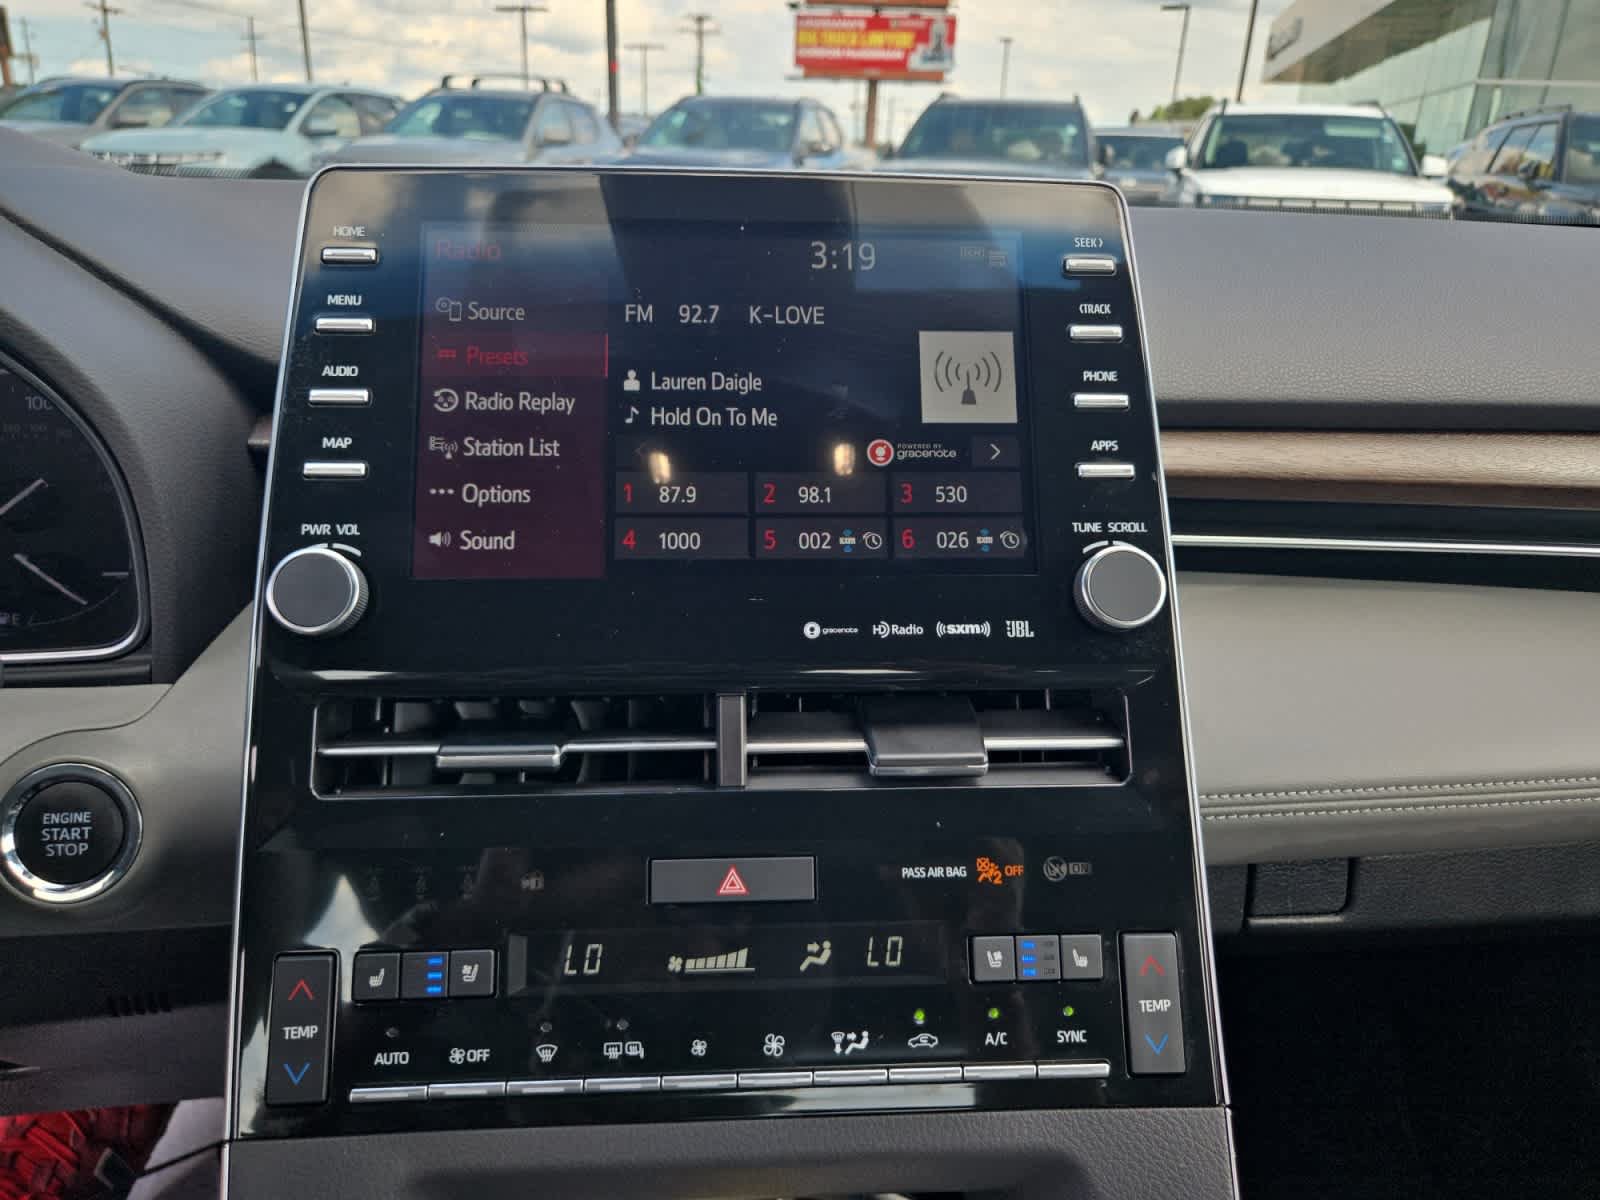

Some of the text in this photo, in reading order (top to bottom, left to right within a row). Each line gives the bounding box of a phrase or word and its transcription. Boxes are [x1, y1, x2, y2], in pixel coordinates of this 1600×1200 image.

[333, 226, 365, 237] HOME
[437, 240, 501, 260] Radio
[1074, 238, 1097, 248] SEEK
[810, 240, 876, 271] 3:19
[327, 295, 362, 306] MENU
[467, 302, 525, 322] Source
[625, 304, 825, 325] FM 92.7 K-LOVE
[1083, 304, 1111, 314] TRACK
[466, 346, 529, 367] Presets
[322, 366, 358, 377] AUDIO
[1083, 371, 1118, 382] PHONE
[651, 371, 762, 395] Lauren Daigle
[465, 392, 576, 415] Radio Replay
[651, 407, 777, 426] Hold On To Me
[322, 437, 352, 449] MAP
[463, 436, 560, 457] Station List
[1091, 440, 1118, 451] APPS
[897, 449, 957, 460] gracenote
[462, 483, 531, 507] Options
[623, 483, 697, 504] 1 87.9
[763, 484, 832, 504] 2 98.1
[901, 483, 967, 503] 3 530
[301, 524, 360, 535] PWR VOL
[1072, 522, 1148, 533] TUNE SCROLL
[459, 531, 515, 550] Sound
[622, 529, 701, 550] 4 1000
[764, 530, 776, 550] 5
[798, 532, 832, 549] 002
[902, 529, 915, 549] 6
[936, 532, 969, 549] 026
[891, 621, 924, 635] Radio
[1005, 620, 1034, 638] JBL
[42, 811, 92, 825] ENGINE
[41, 826, 92, 841] START
[46, 842, 89, 857] STOP
[902, 866, 967, 878] PASS AIR BAG
[1005, 864, 1024, 877] OFF
[867, 936, 903, 968] LO
[564, 944, 603, 976] LO
[1138, 999, 1171, 1013] TEMP
[283, 1025, 318, 1040] TEMP
[985, 1031, 1008, 1046] A/C
[1057, 1030, 1087, 1044] SYNC
[374, 1051, 410, 1065] AUTO
[467, 1049, 490, 1062] OFF
